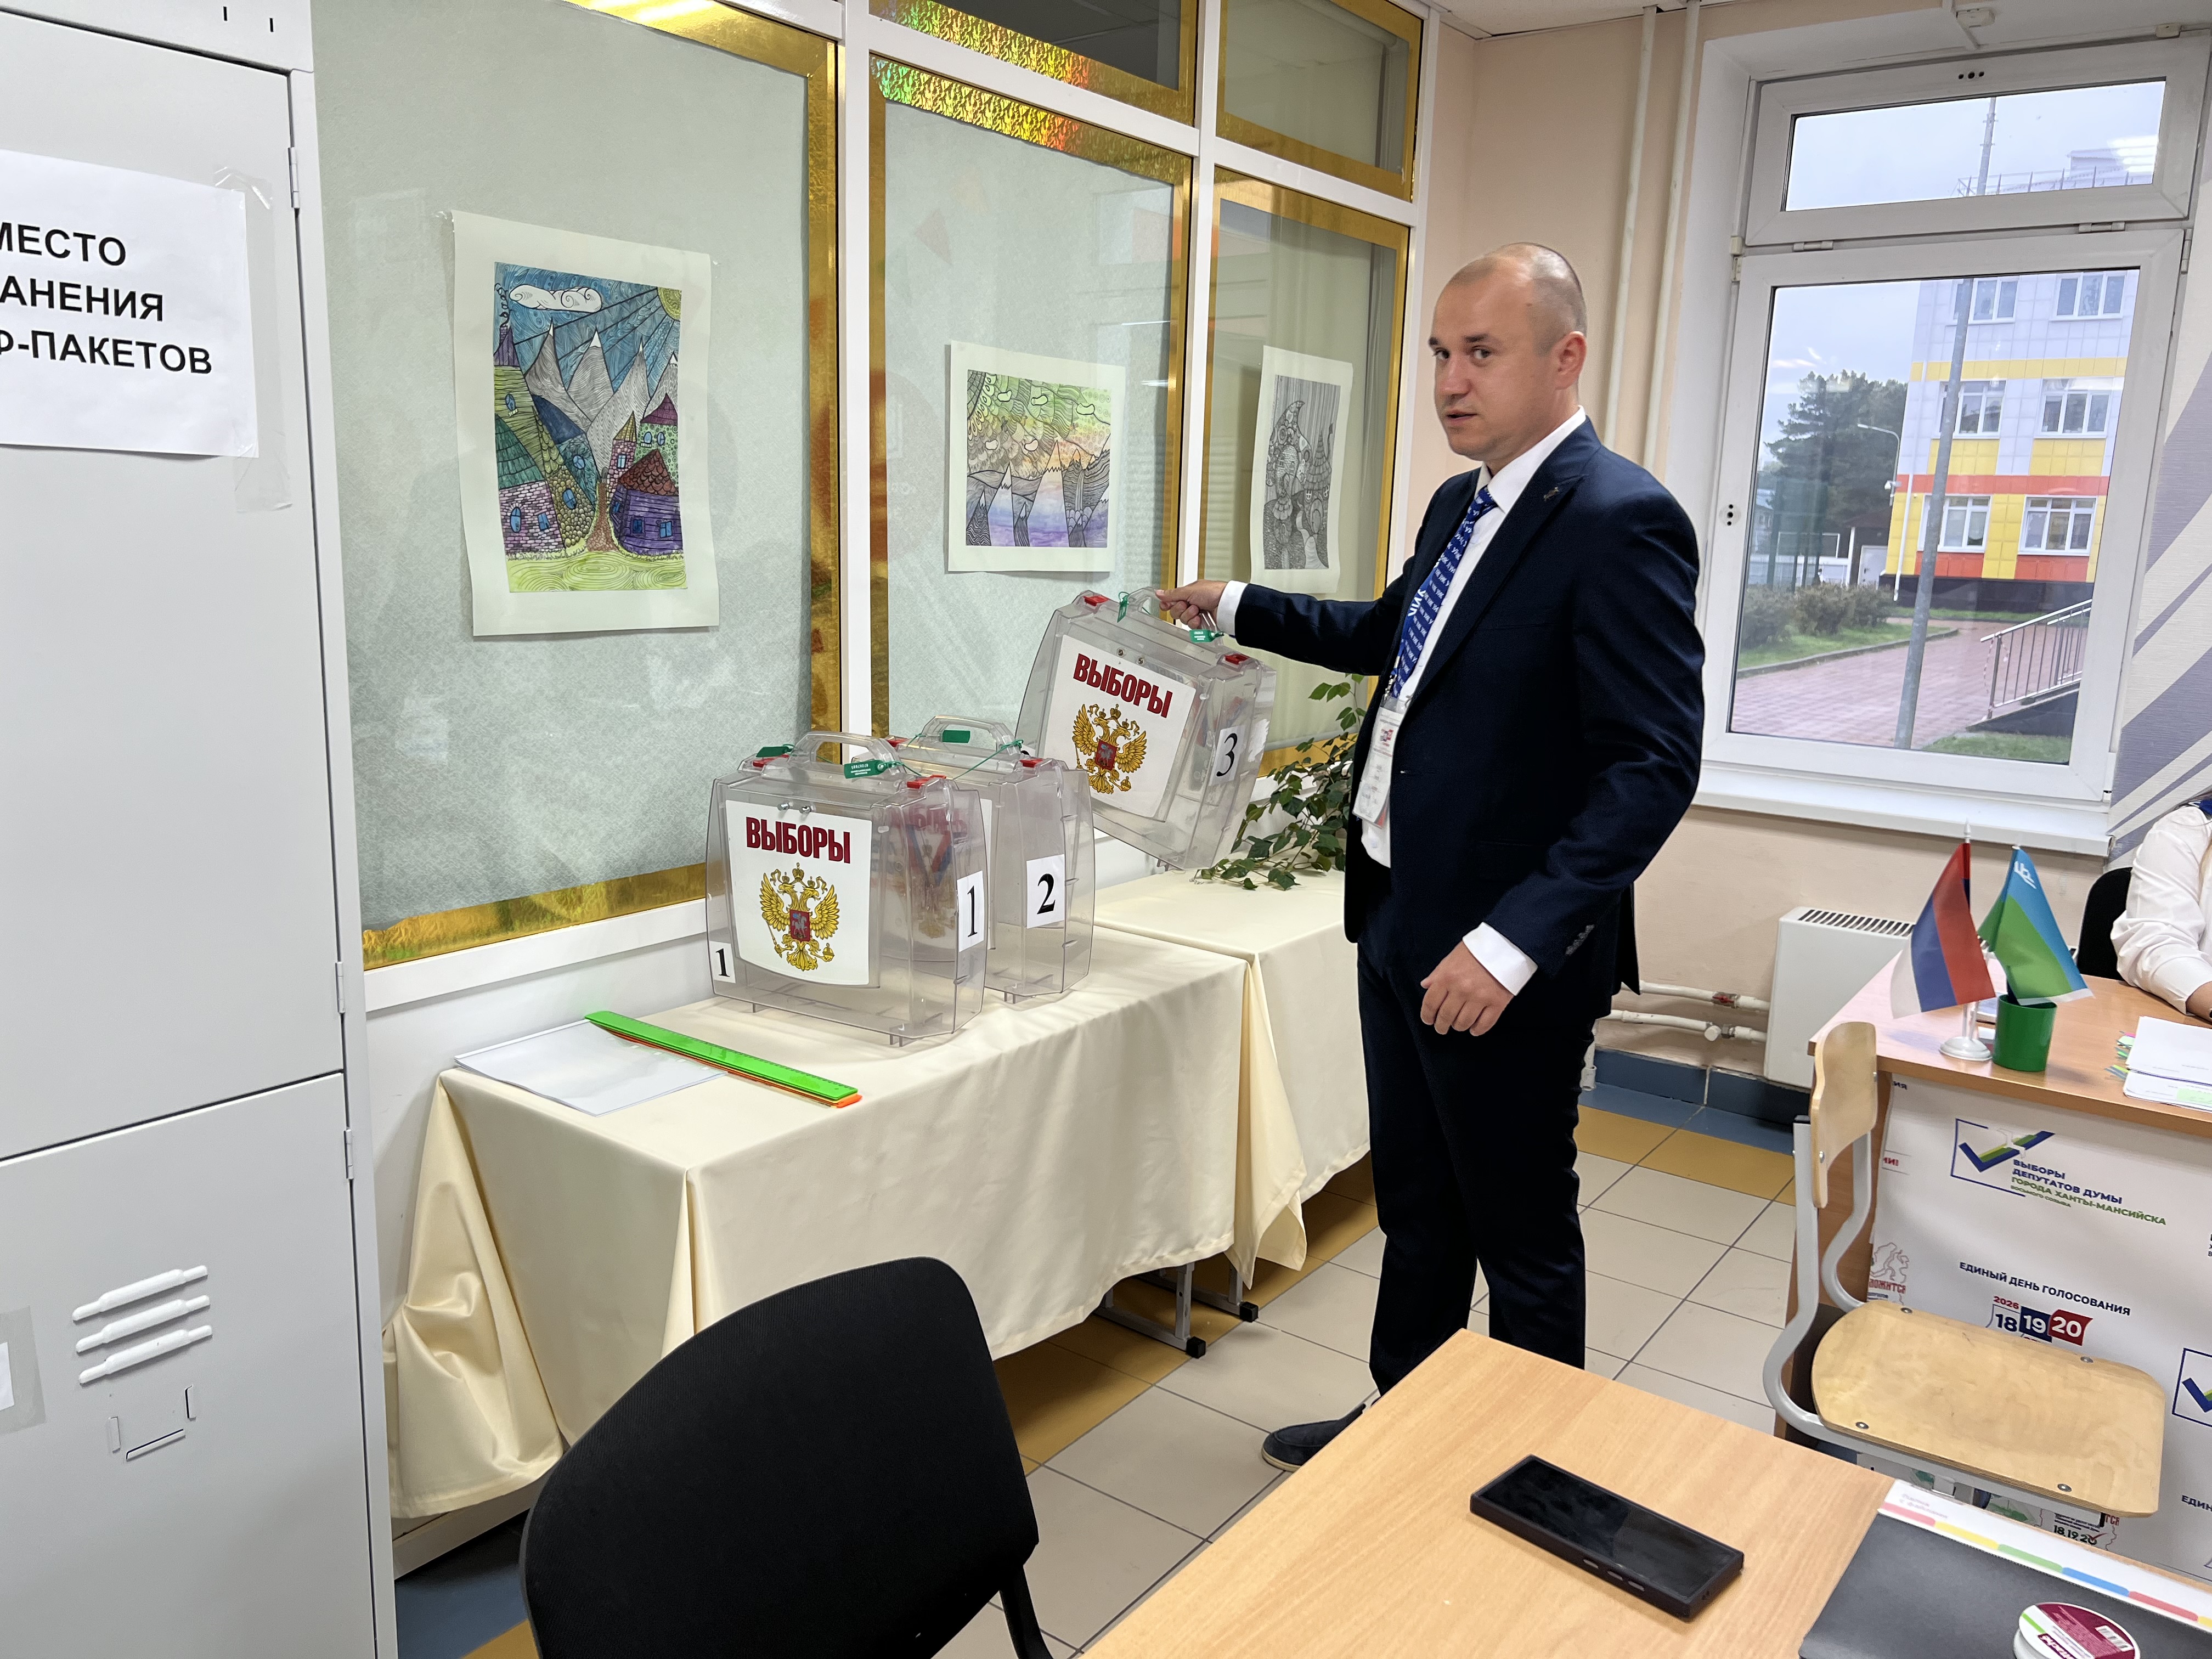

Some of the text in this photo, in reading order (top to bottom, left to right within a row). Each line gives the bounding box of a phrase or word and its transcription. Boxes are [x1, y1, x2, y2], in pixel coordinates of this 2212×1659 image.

[1073, 653, 1173, 718] ВЫБОРЫ
[1216, 733, 1238, 777] 3
[746, 816, 851, 864] ВЫБОРЫ
[967, 885, 978, 938] 1
[1037, 873, 1056, 915] 2
[715, 948, 731, 978] 1
[2012, 1169, 2123, 1204] ДЕПУТАТОВ ДУМЫ
[2013, 1159, 2066, 1179] ВЫБОРЫ
[2012, 1177, 2166, 1225] ГОРОДА ХАНТЫ-МАНСИЙСКА
[1960, 1262, 2131, 1316] ЕДИНЫЙ ДЕНЬ ГОЛОСОВАНИЯ
[1994, 1296, 2019, 1310] 2026
[1995, 1313, 2082, 1337] 18 19 20
